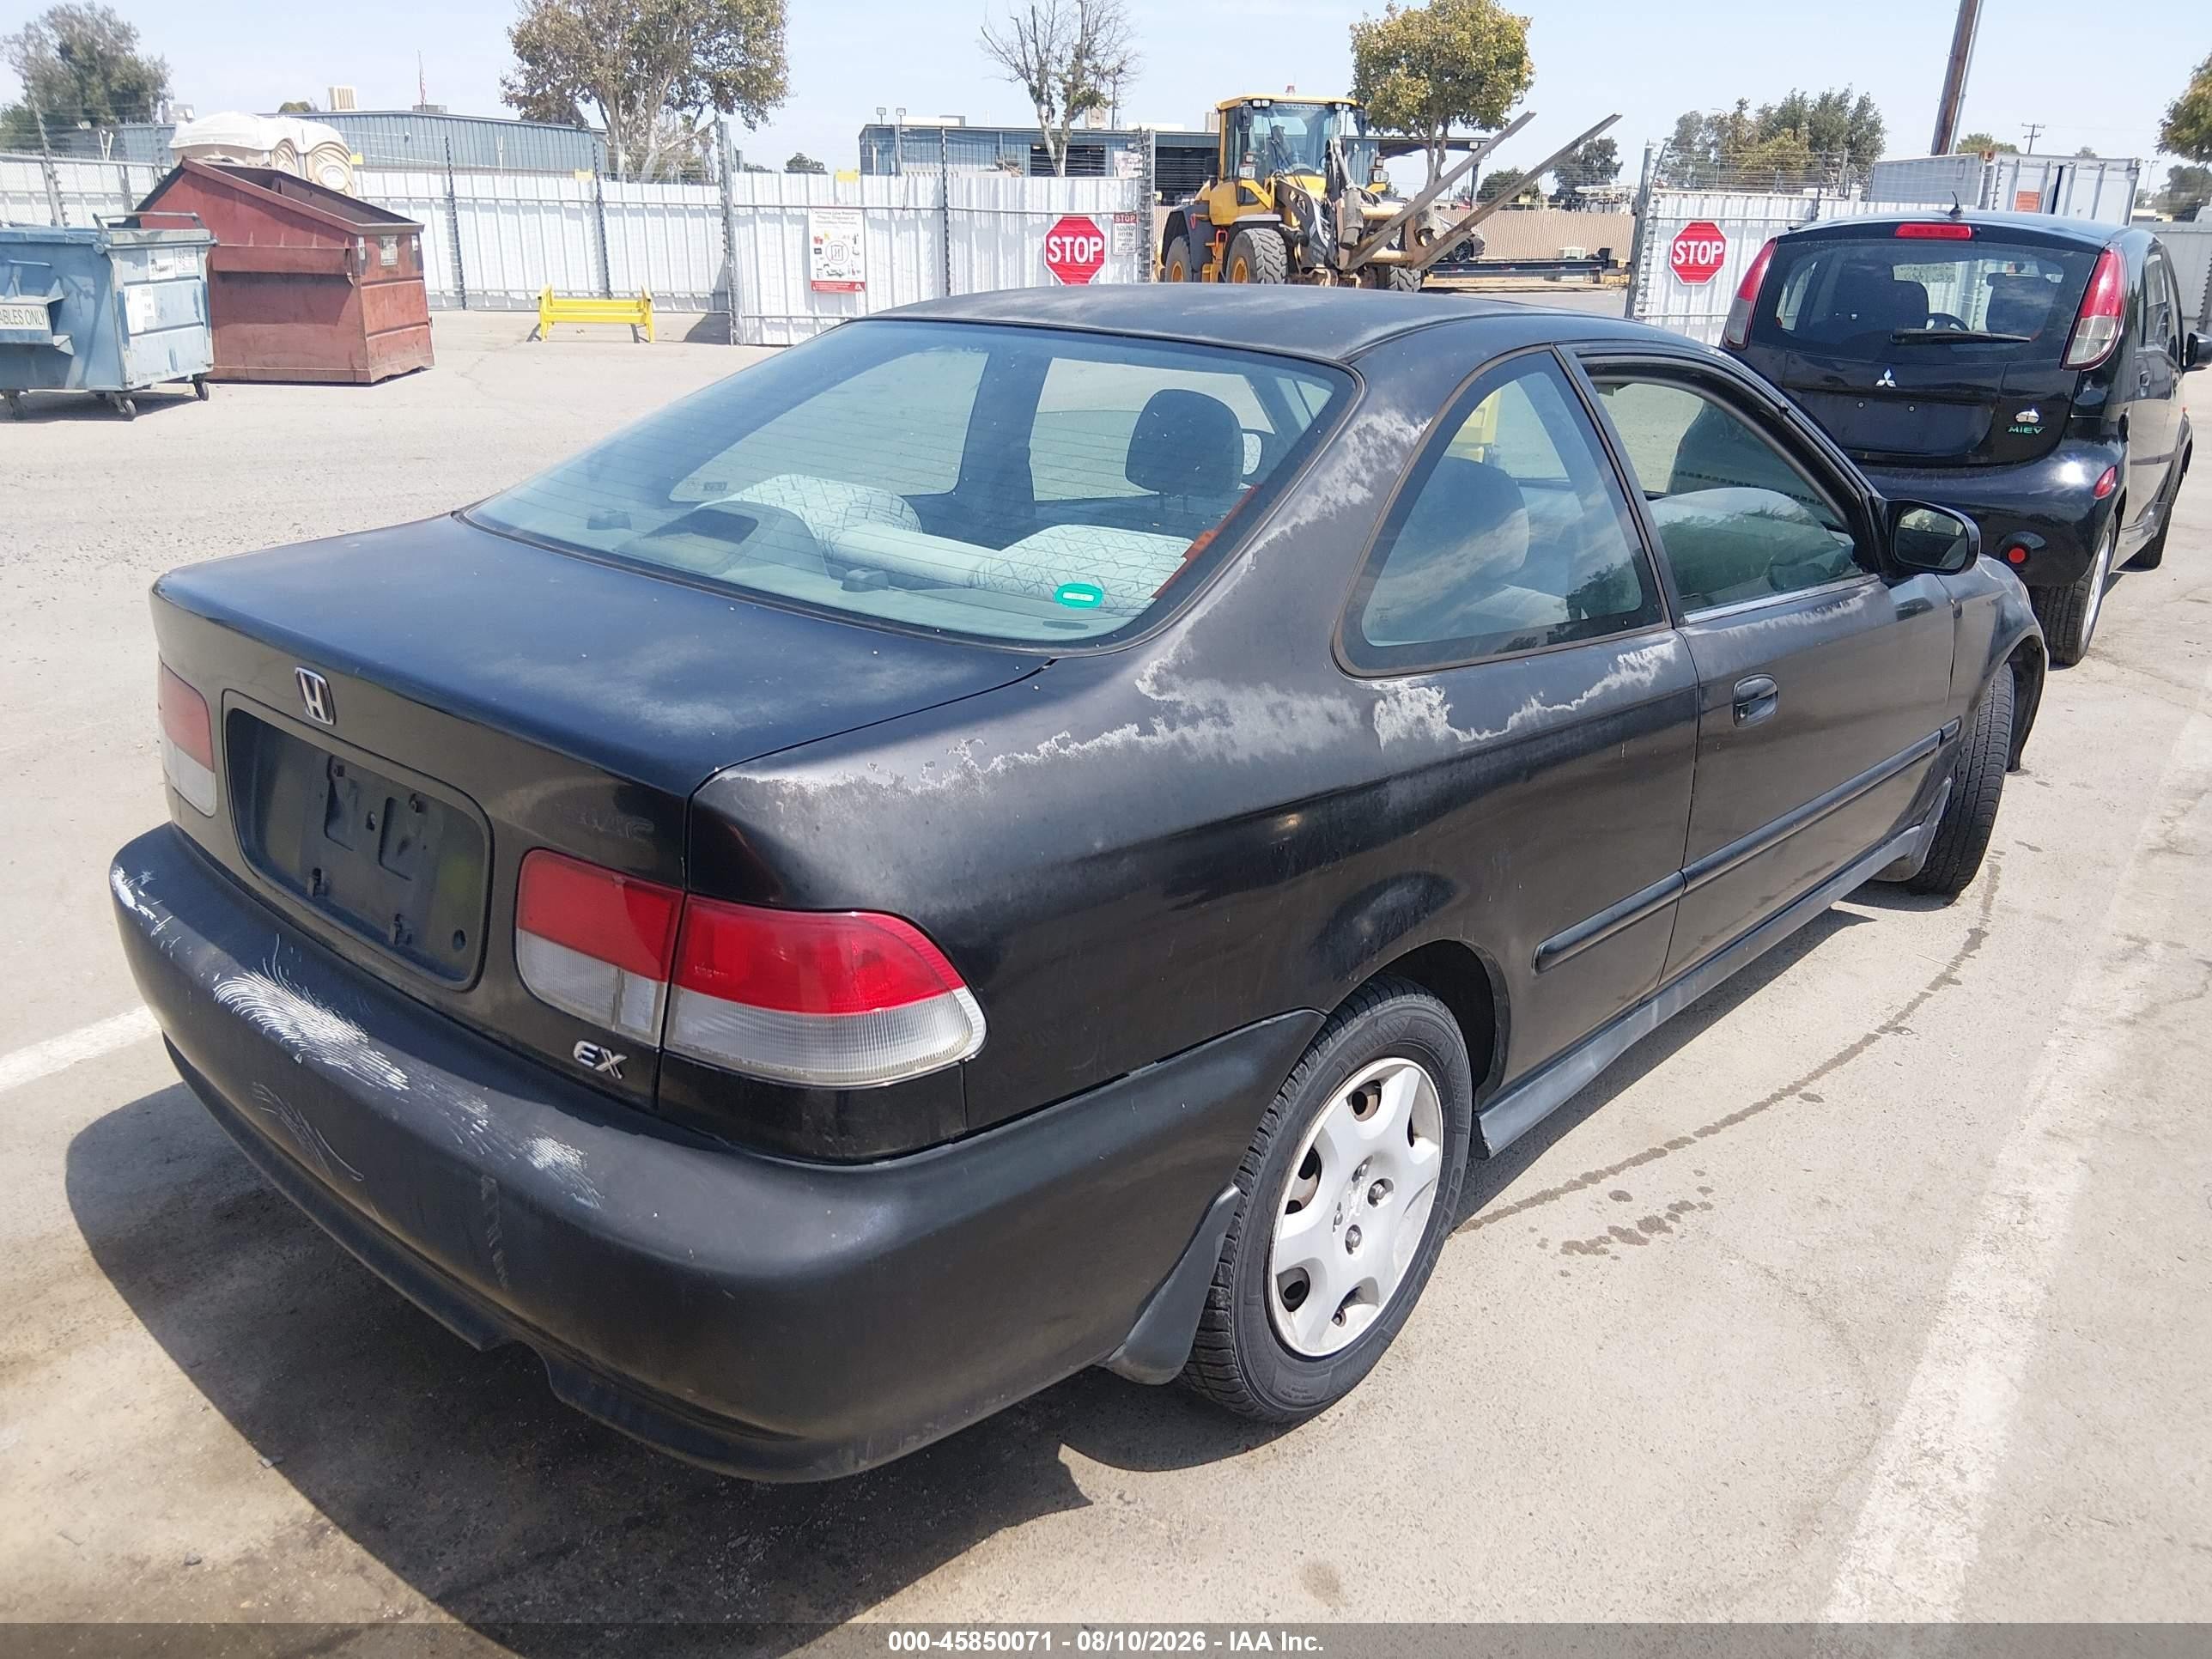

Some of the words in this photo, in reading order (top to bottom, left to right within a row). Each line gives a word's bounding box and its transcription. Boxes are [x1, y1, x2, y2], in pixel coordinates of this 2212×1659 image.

[1115, 214, 1136, 222] STOP
[1047, 235, 1103, 264] STOP
[1672, 240, 1724, 265] STOP
[25, 308, 46, 326] ONLY
[2007, 425, 2046, 434] MIEV
[573, 1040, 628, 1079] EX
